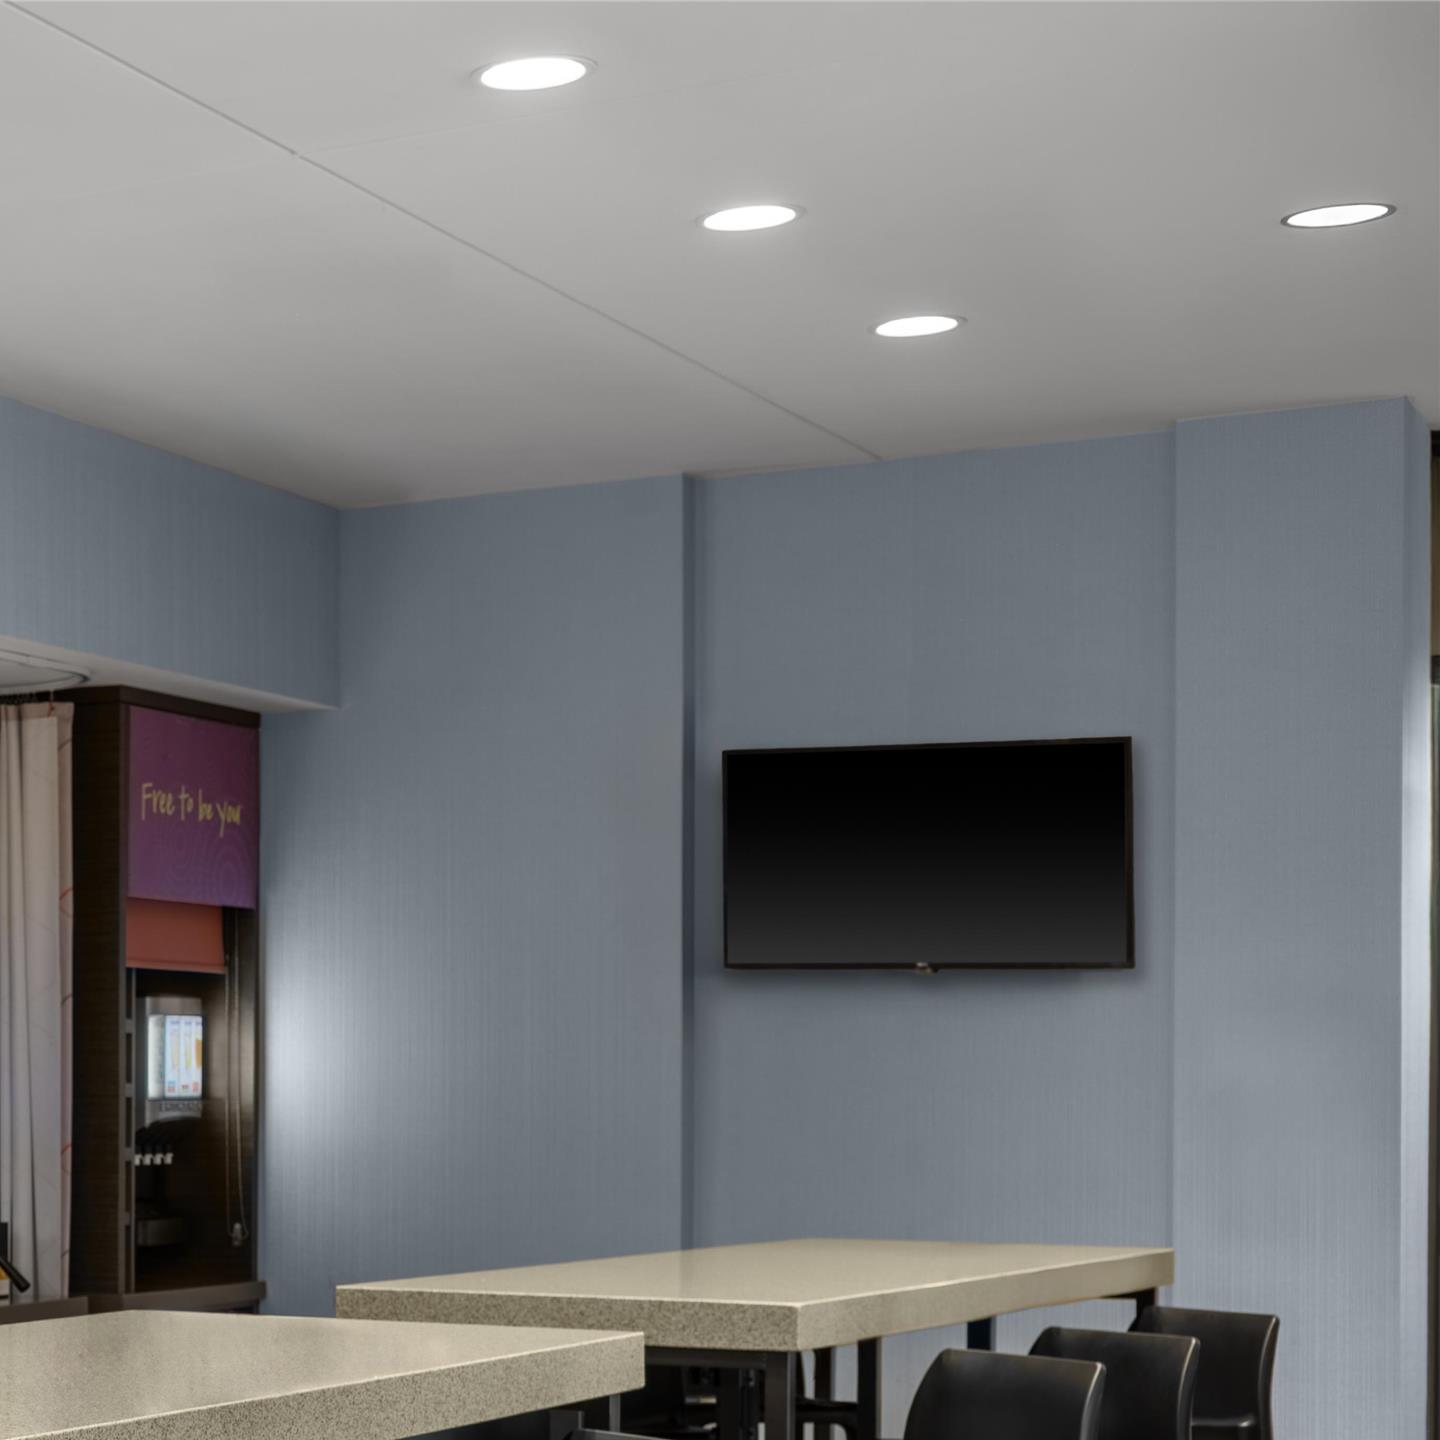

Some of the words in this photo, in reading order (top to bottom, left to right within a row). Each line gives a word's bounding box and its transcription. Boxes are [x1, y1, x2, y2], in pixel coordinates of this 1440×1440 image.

[141, 782, 176, 821] Free
[178, 784, 194, 821] to
[198, 788, 214, 822] be
[216, 801, 243, 839] you
